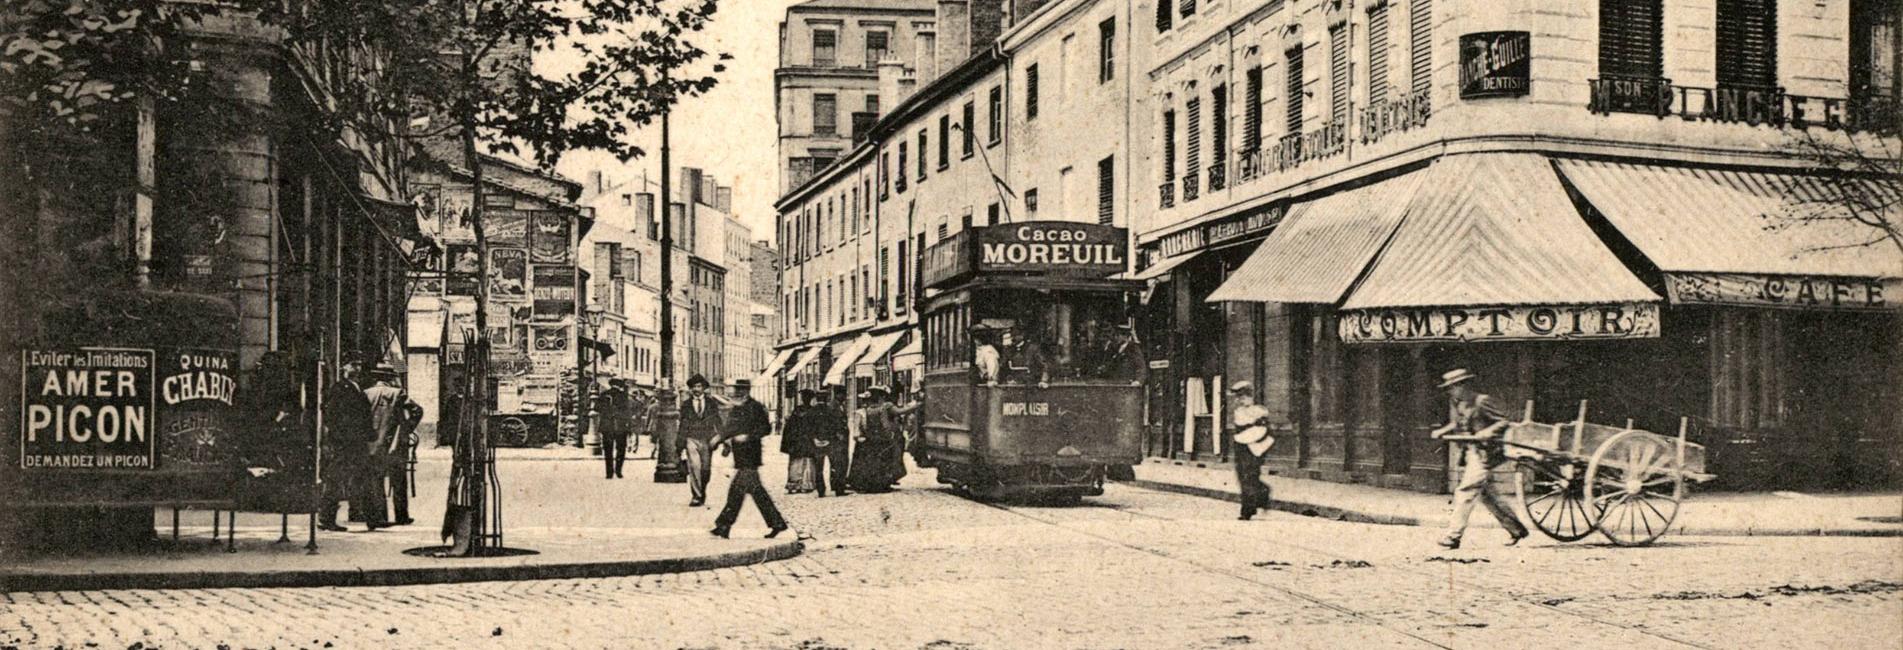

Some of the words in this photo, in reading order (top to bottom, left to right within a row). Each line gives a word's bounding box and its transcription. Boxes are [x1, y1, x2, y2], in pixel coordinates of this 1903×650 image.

[1017, 226, 1087, 241] Cacao
[982, 243, 1122, 264] MOREUIL
[1358, 307, 1634, 337] COMPTOIR
[31, 351, 72, 367] Eviter
[87, 352, 149, 368] Imitations
[180, 354, 229, 370] QUINA
[41, 369, 137, 397] AMER
[162, 371, 237, 406] CHABLY
[27, 404, 146, 443] PICON
[26, 455, 94, 467] DEMANDEZ
[96, 455, 113, 467] UN
[114, 455, 149, 467] PICON
